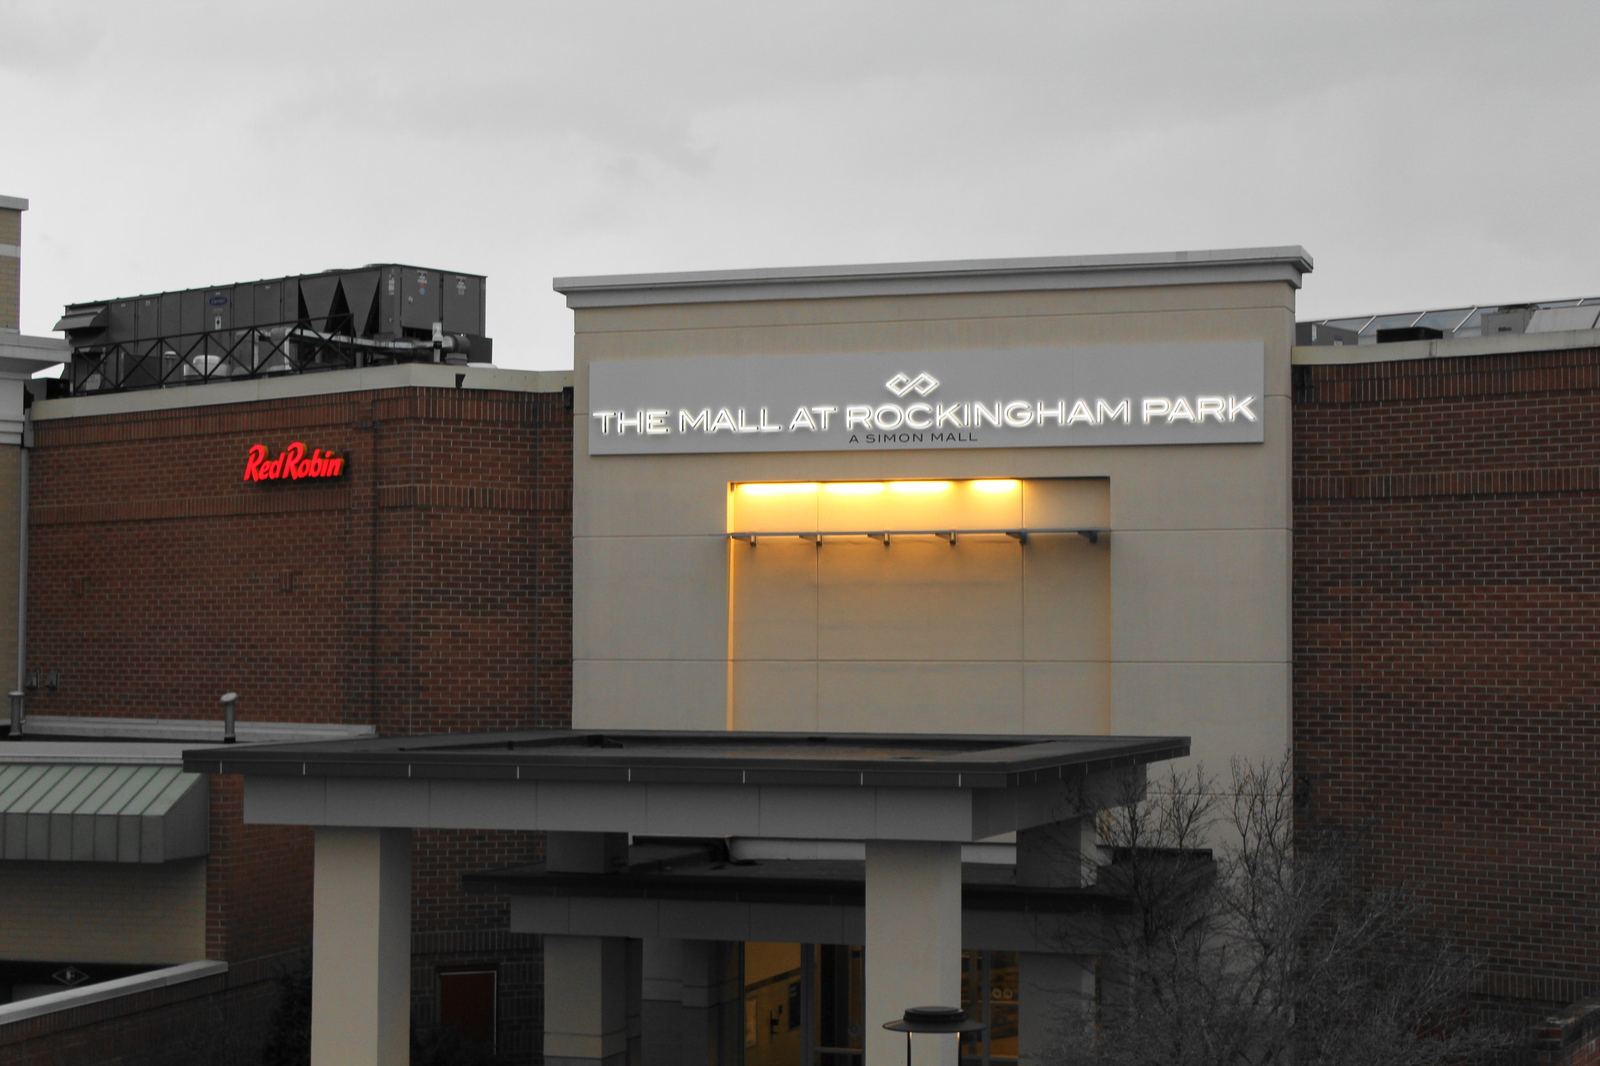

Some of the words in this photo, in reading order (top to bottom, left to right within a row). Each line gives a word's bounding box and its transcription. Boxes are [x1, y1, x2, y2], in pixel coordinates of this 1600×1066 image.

[591, 408, 673, 435] THE
[678, 407, 783, 434] MALL
[788, 405, 839, 432] AT
[845, 398, 1133, 431] ROCKINGHAM
[1141, 394, 1258, 425] PARK
[848, 434, 860, 444] A
[866, 433, 924, 444] SIMON
[931, 431, 978, 442] MALL
[243, 444, 286, 481] Red
[282, 441, 344, 480] Robin
